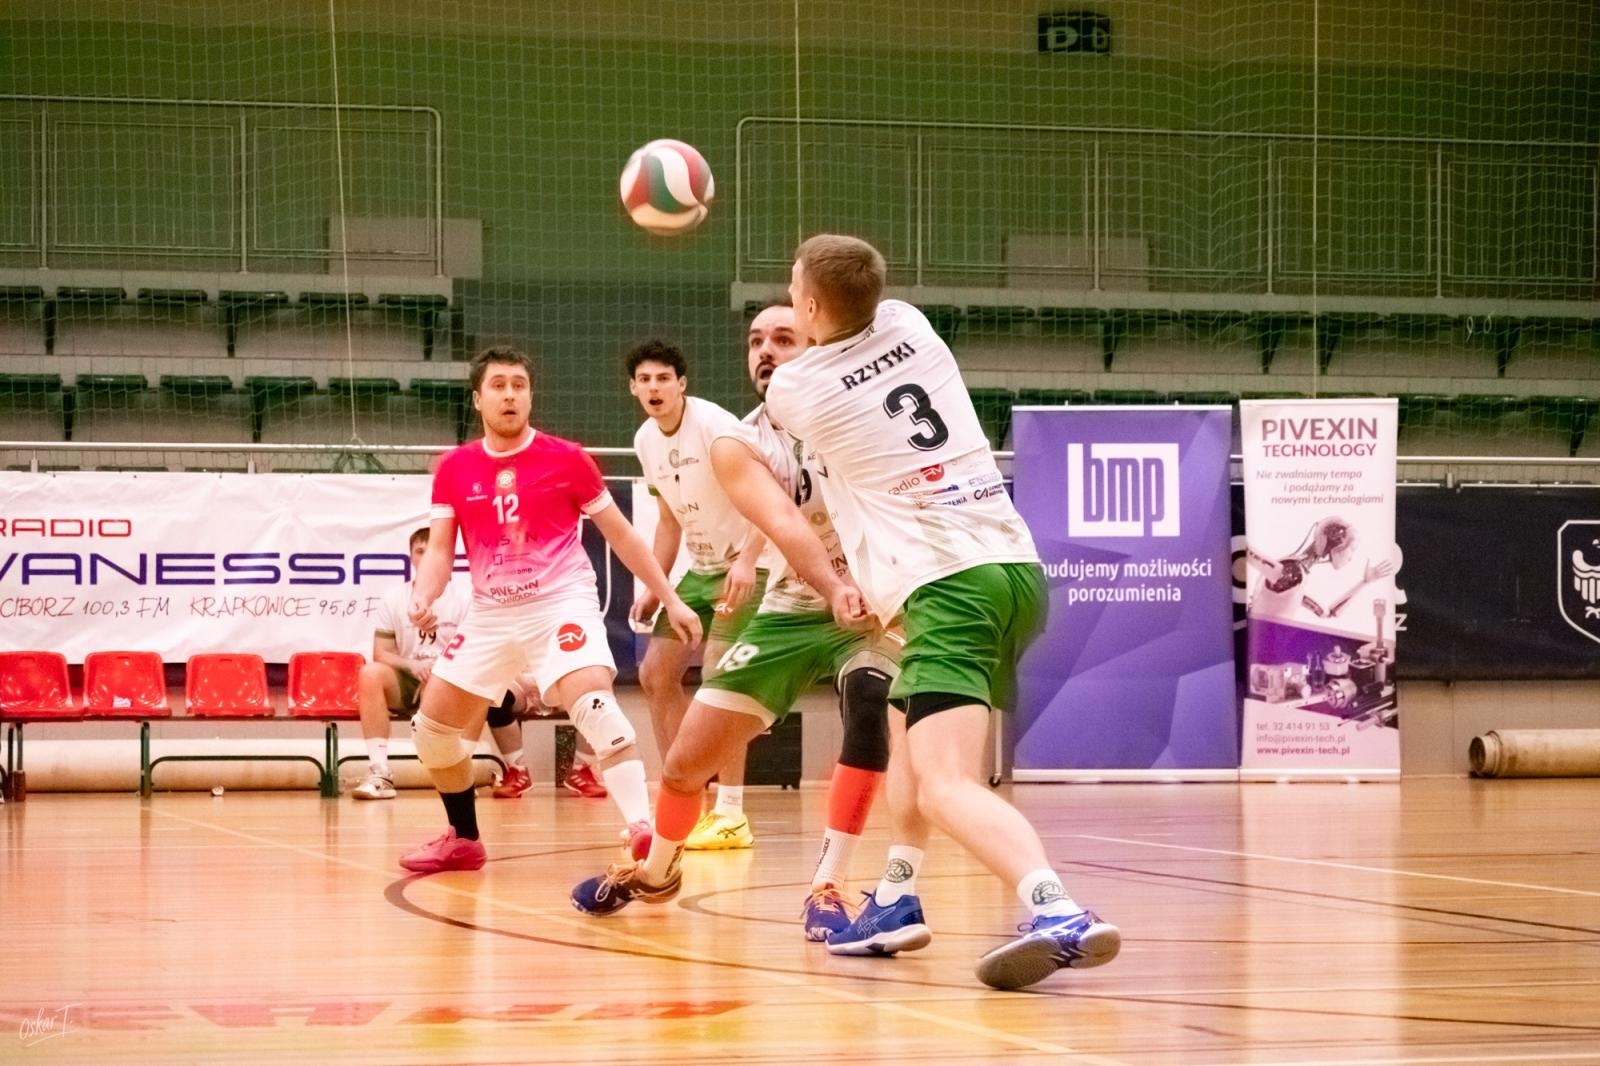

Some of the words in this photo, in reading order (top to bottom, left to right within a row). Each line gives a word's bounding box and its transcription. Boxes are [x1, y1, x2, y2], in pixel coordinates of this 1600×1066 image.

[841, 341, 917, 391] RZYTKI
[883, 383, 949, 451] 3
[1261, 417, 1378, 442] PIVEXIN
[1262, 443, 1377, 458] TECHNOLOGY
[1256, 470, 1272, 479] Nie
[1275, 469, 1328, 480] zwalniamy
[1331, 470, 1363, 480] tempa
[1271, 494, 1311, 506] nowymi
[1313, 493, 1384, 506] technologiami
[492, 493, 520, 525] 12
[0, 519, 132, 537] ADIO
[1124, 558, 1212, 577] możliwości
[1069, 584, 1182, 606] porozumienia
[83, 600, 130, 618] 100,3
[136, 596, 170, 618] FM
[189, 595, 316, 618] KRAPKOWICE
[319, 599, 358, 617] 95,8
[362, 596, 382, 618] F
[1286, 722, 1303, 731] 414
[1305, 722, 1316, 731] 91
[1256, 734, 1346, 744] info@pivexin-tech.pl
[1256, 745, 1351, 756] www.pivexin-tech.pl
